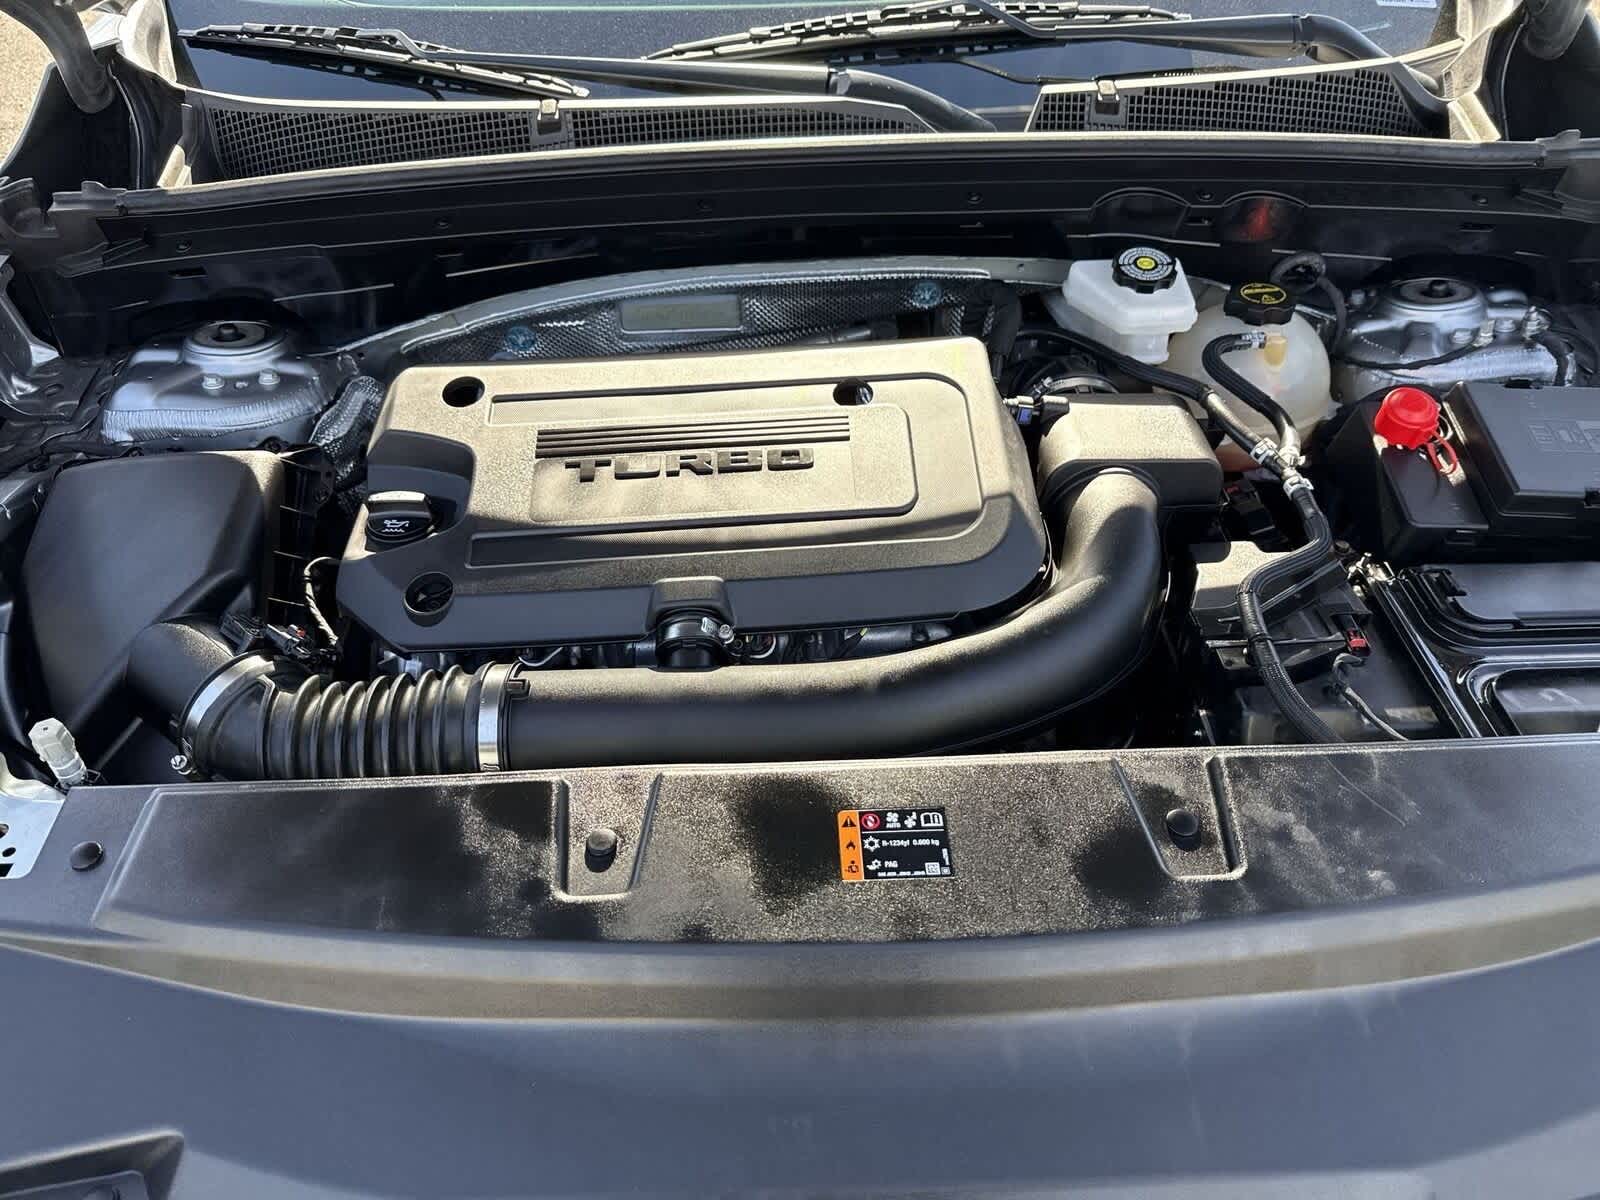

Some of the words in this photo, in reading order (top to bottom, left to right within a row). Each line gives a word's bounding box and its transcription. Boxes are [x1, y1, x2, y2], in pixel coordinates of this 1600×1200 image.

[564, 447, 814, 483] TURBO
[931, 838, 940, 847] kg
[884, 860, 898, 868] PAG
